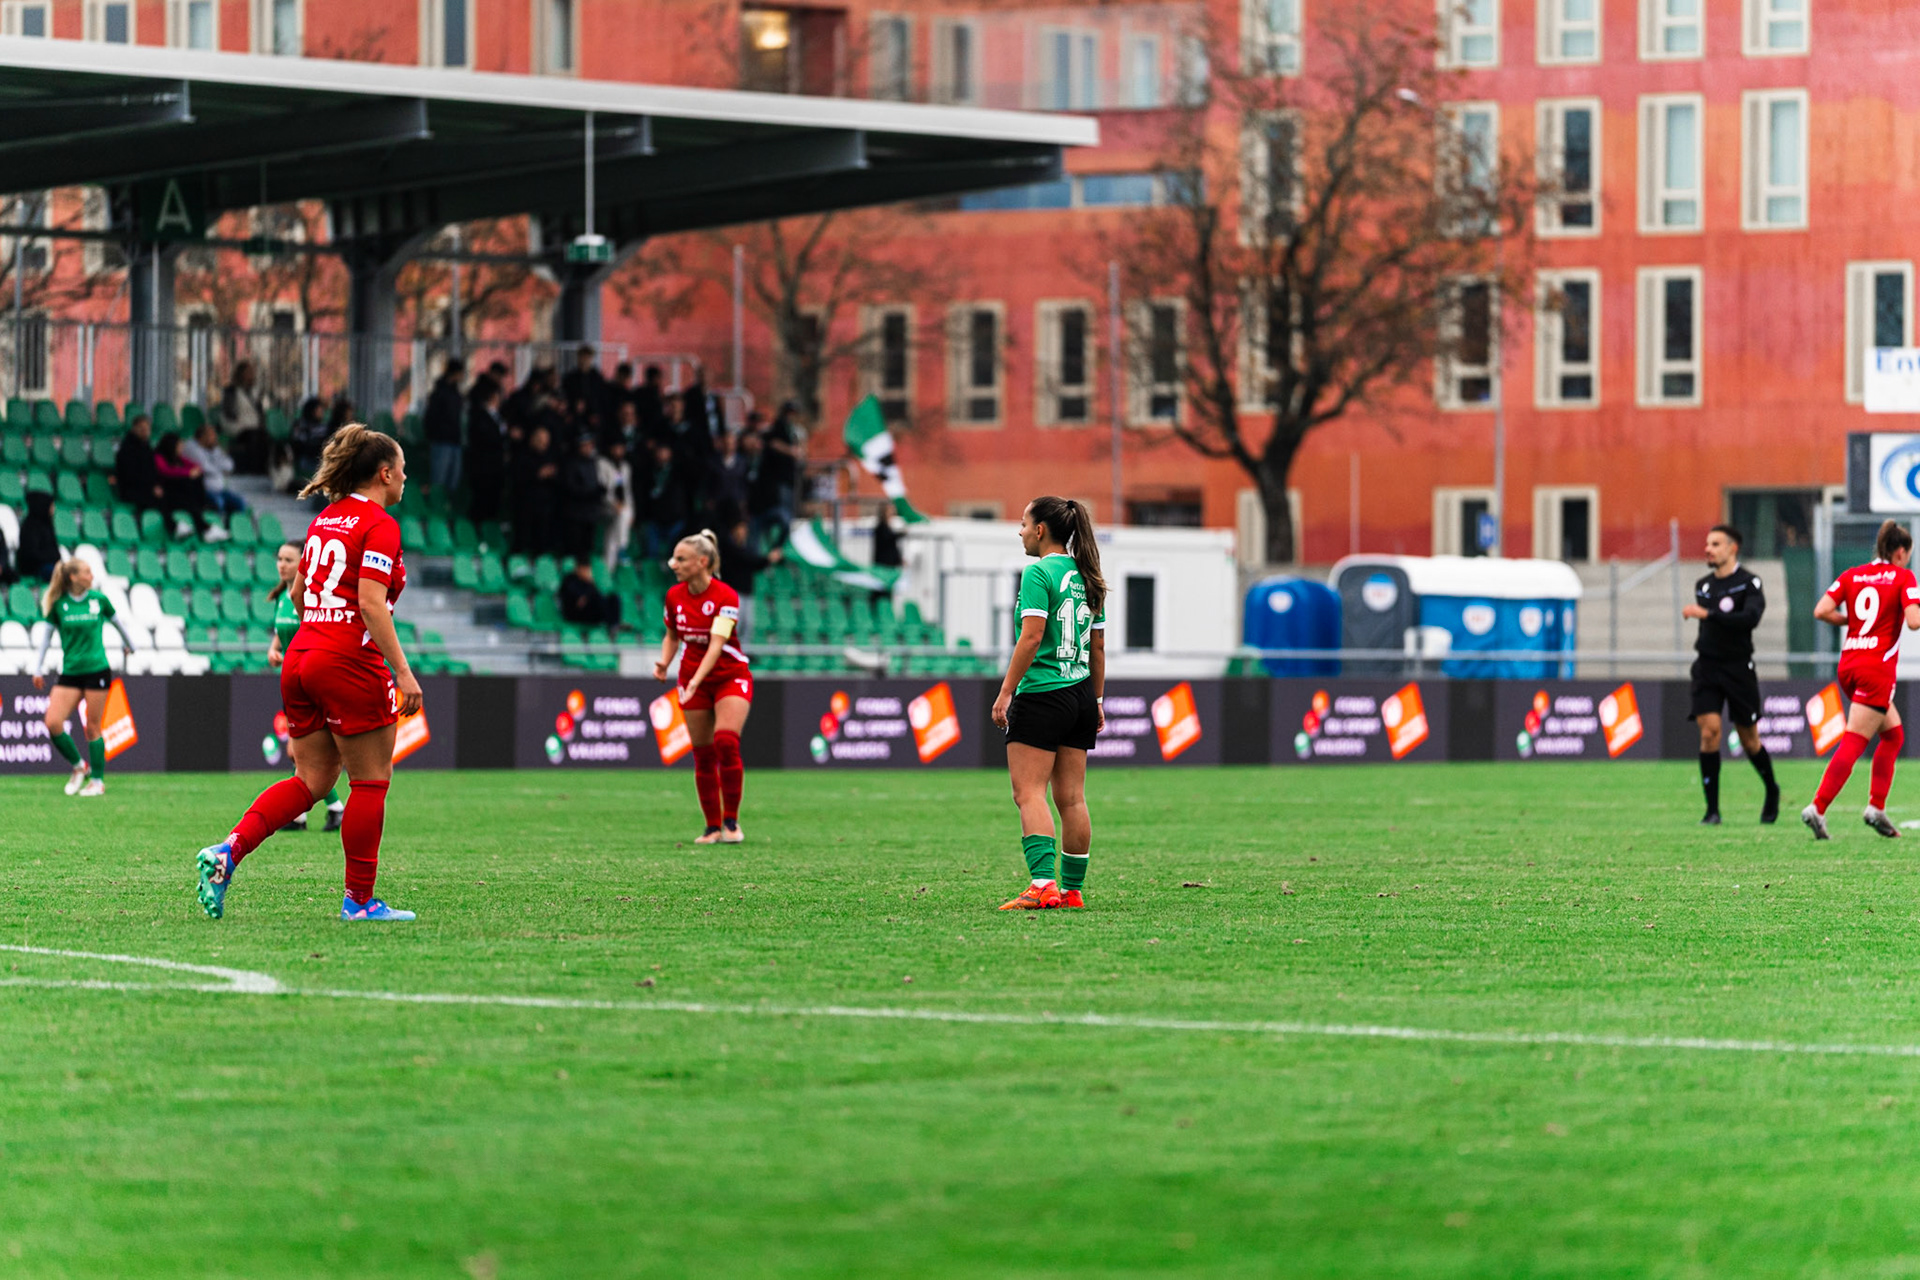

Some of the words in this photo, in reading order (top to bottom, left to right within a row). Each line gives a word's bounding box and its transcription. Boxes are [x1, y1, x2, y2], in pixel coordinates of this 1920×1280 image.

[156, 179, 192, 233] A
[303, 534, 347, 609] 22
[1056, 597, 1094, 664] 12
[1854, 586, 1880, 636] 9
